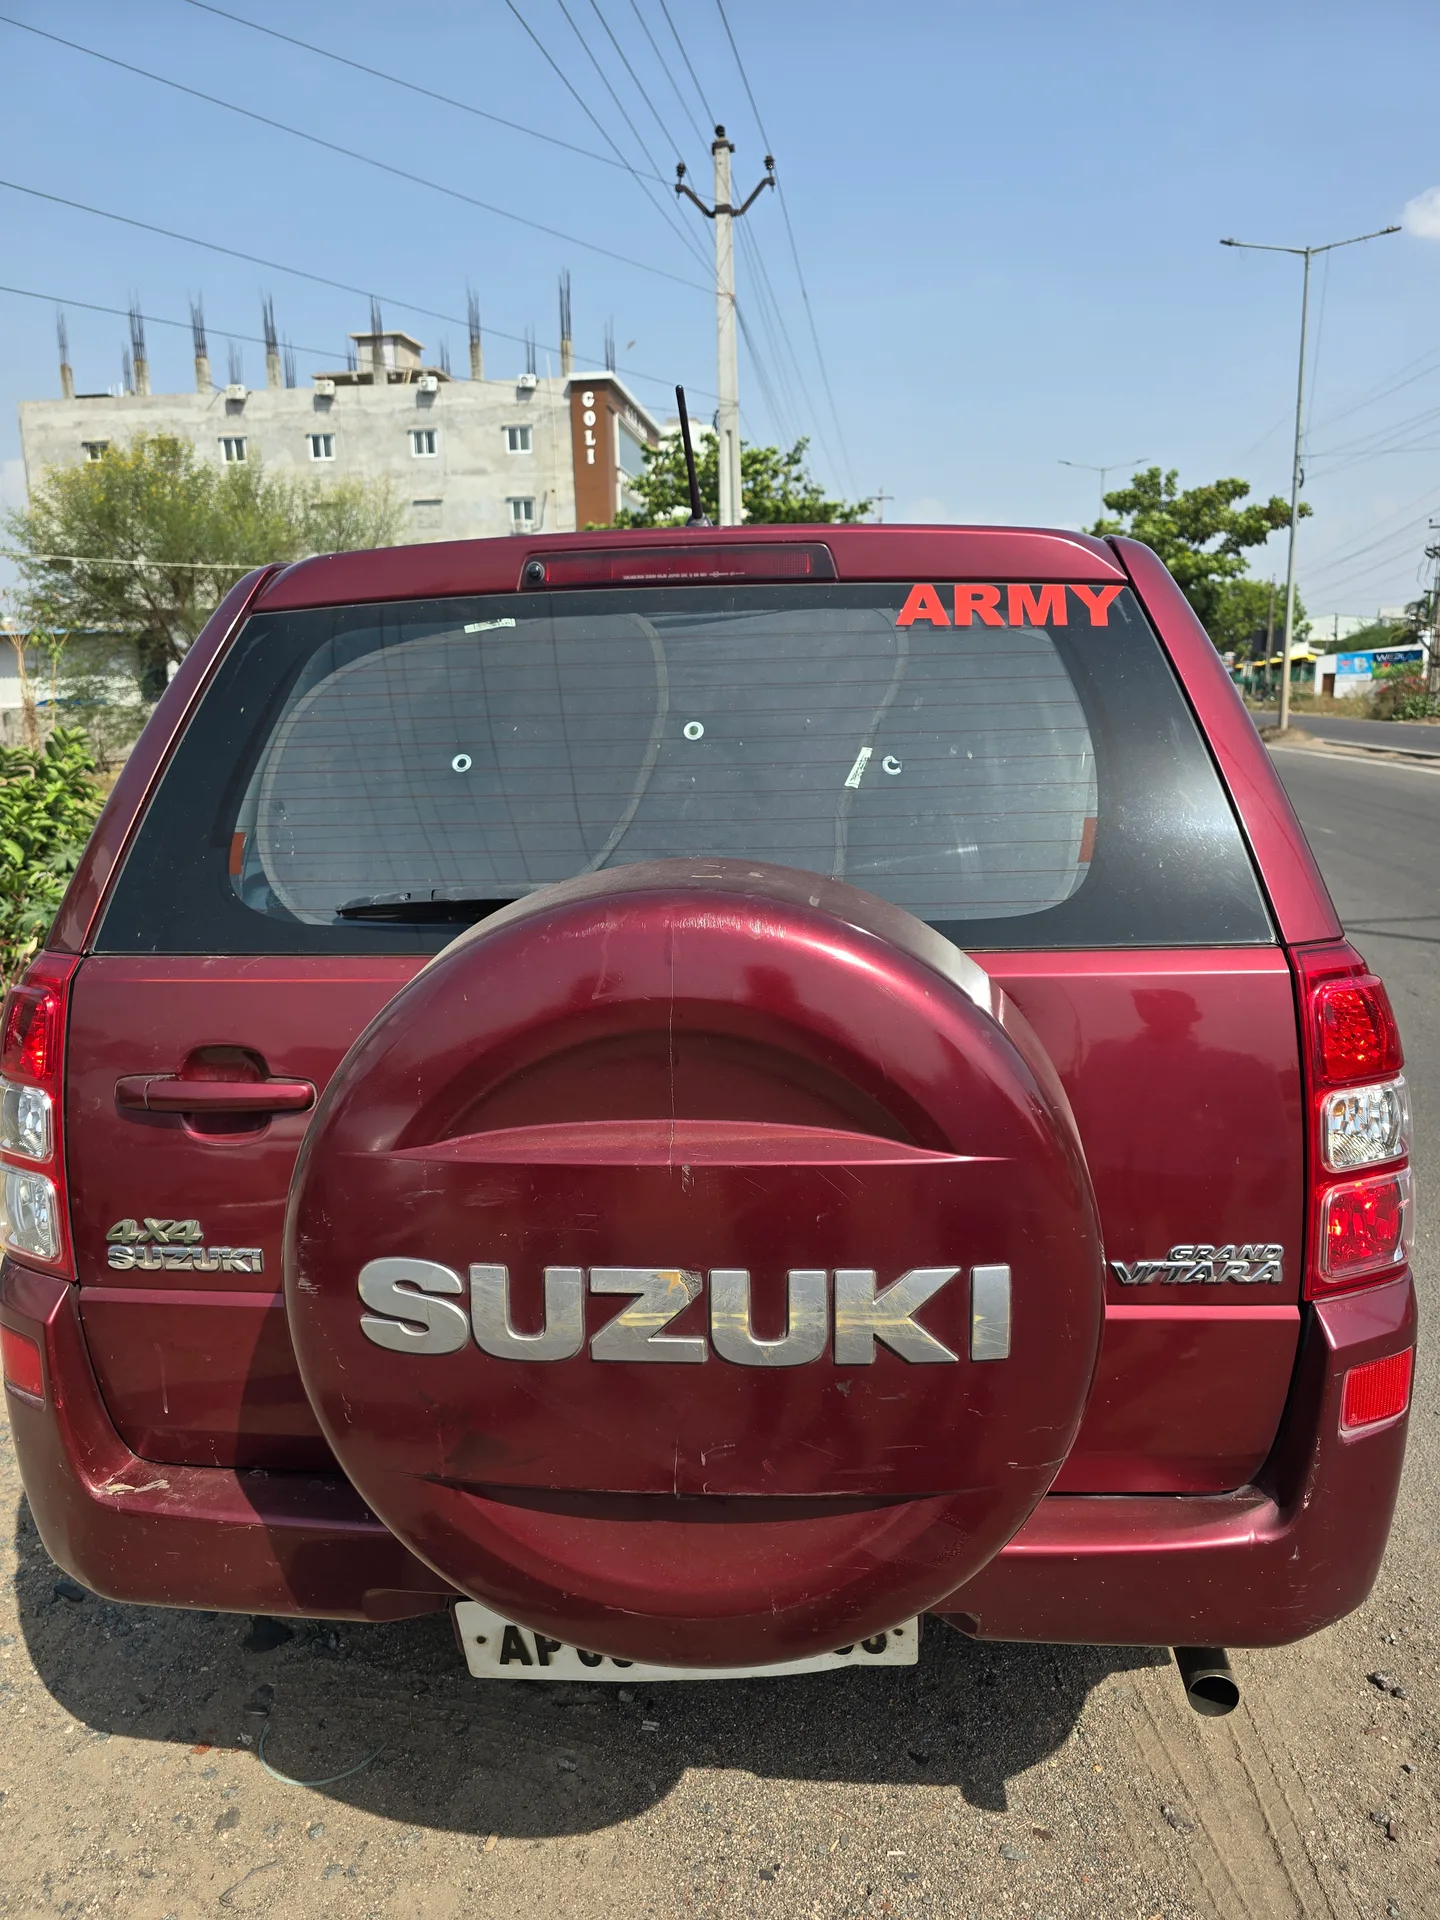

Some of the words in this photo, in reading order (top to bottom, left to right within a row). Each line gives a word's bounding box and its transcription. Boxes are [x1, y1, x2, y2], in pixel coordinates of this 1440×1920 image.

[582, 391, 596, 465] GOLI
[896, 584, 1124, 626] ARMY
[107, 1246, 264, 1273] SUZUKI
[1169, 1244, 1283, 1261] GRAND
[1110, 1260, 1283, 1285] VITARA
[358, 1256, 1012, 1366] SUZUKI
